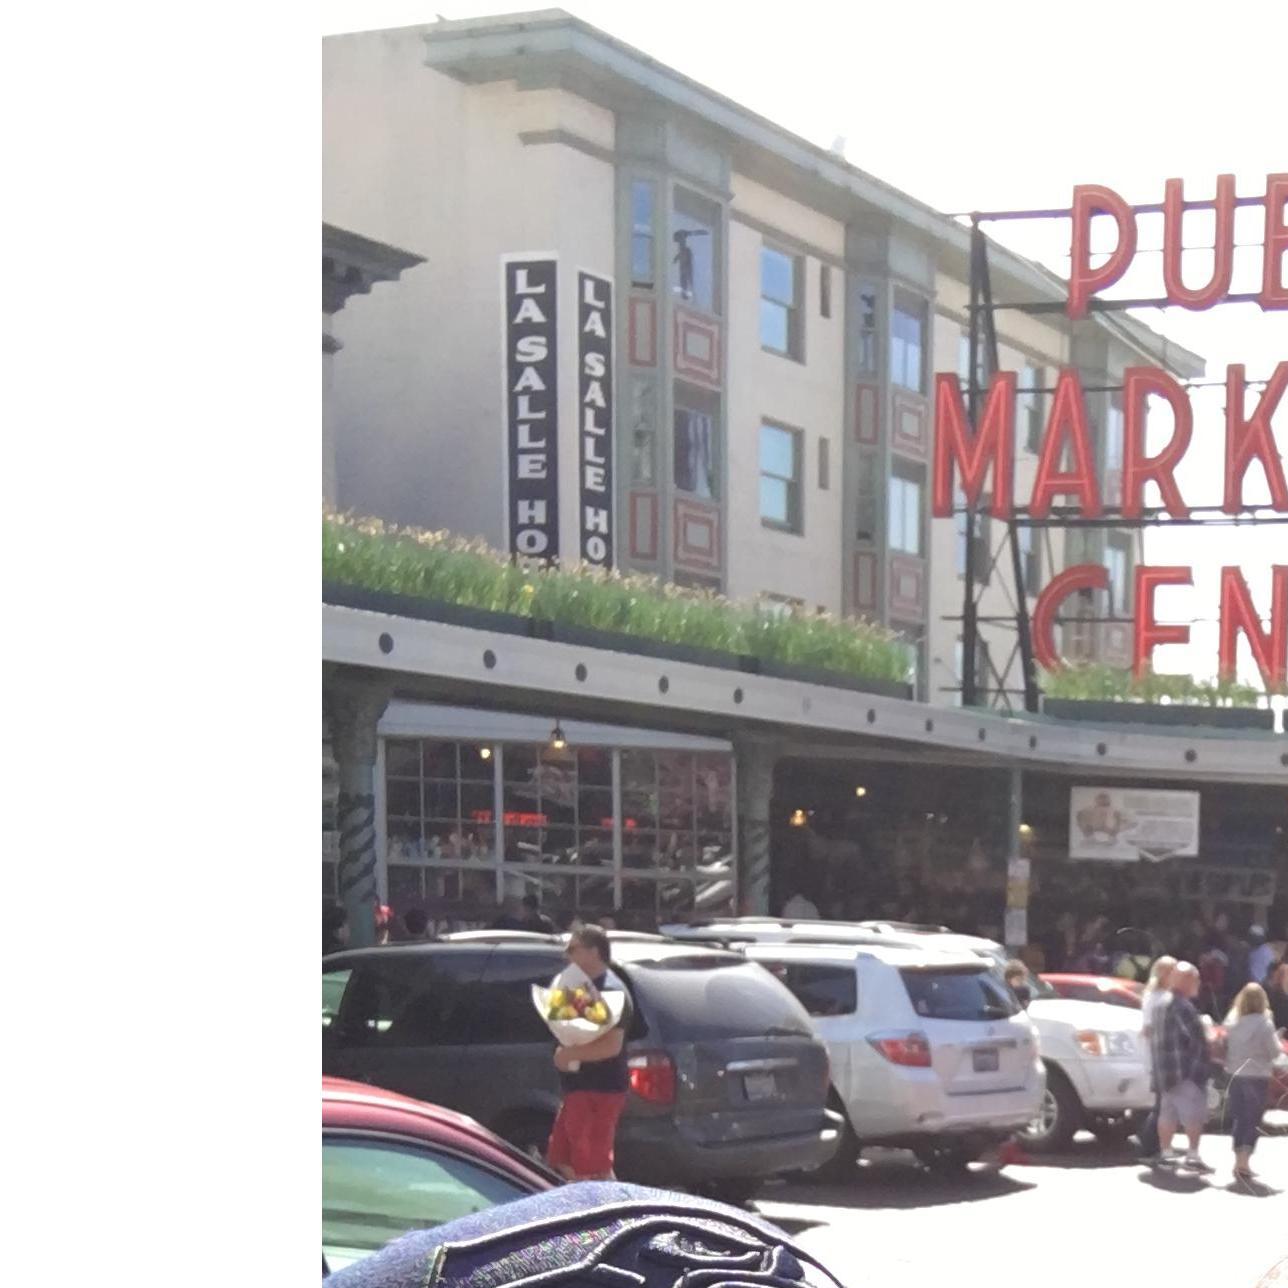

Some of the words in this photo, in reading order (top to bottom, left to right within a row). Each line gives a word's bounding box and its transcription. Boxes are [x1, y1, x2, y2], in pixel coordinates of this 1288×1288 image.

[511, 269, 547, 324] LA
[583, 279, 606, 338] LA
[511, 335, 548, 480] SALLE
[583, 352, 607, 492] SALLE
